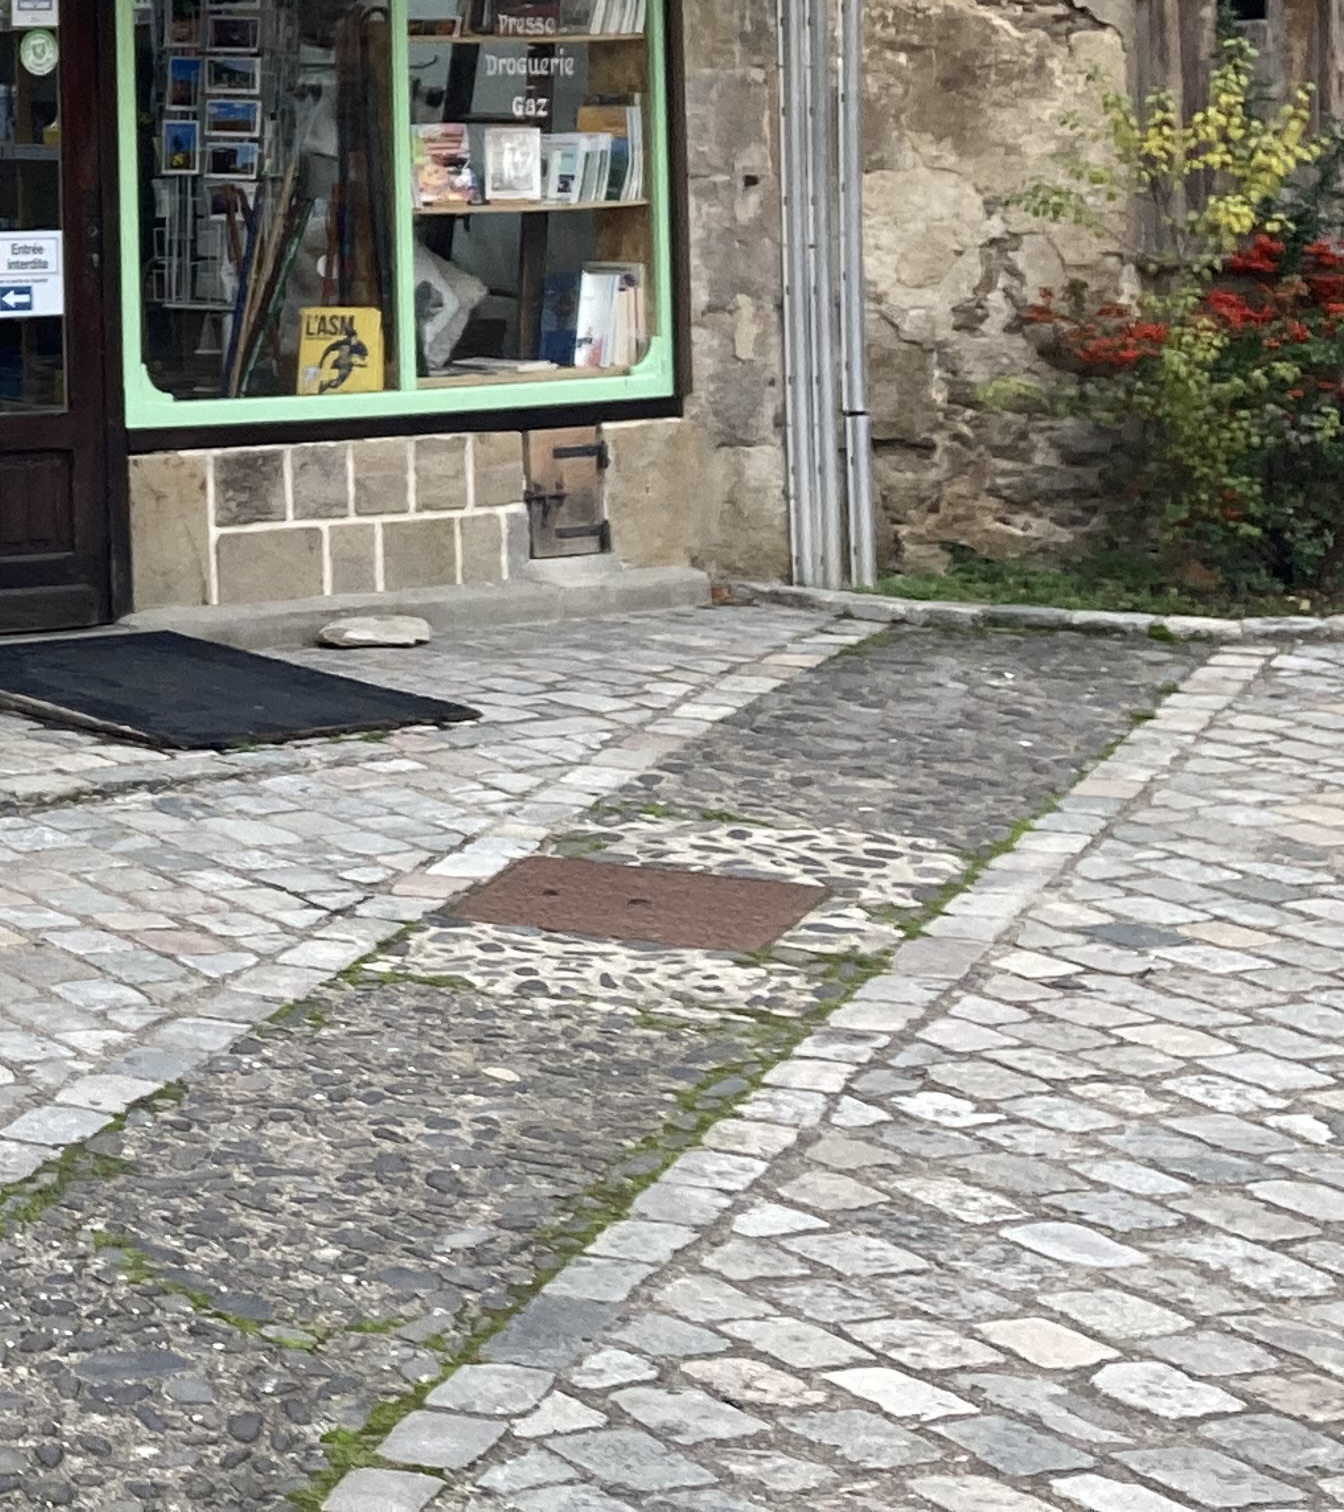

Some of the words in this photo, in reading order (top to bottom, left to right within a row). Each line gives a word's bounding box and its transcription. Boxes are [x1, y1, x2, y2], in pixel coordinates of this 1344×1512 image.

[497, 13, 557, 35] Presse
[485, 48, 575, 76] Droguerie
[512, 95, 549, 117] Gaz
[11, 243, 44, 256] Entrée
